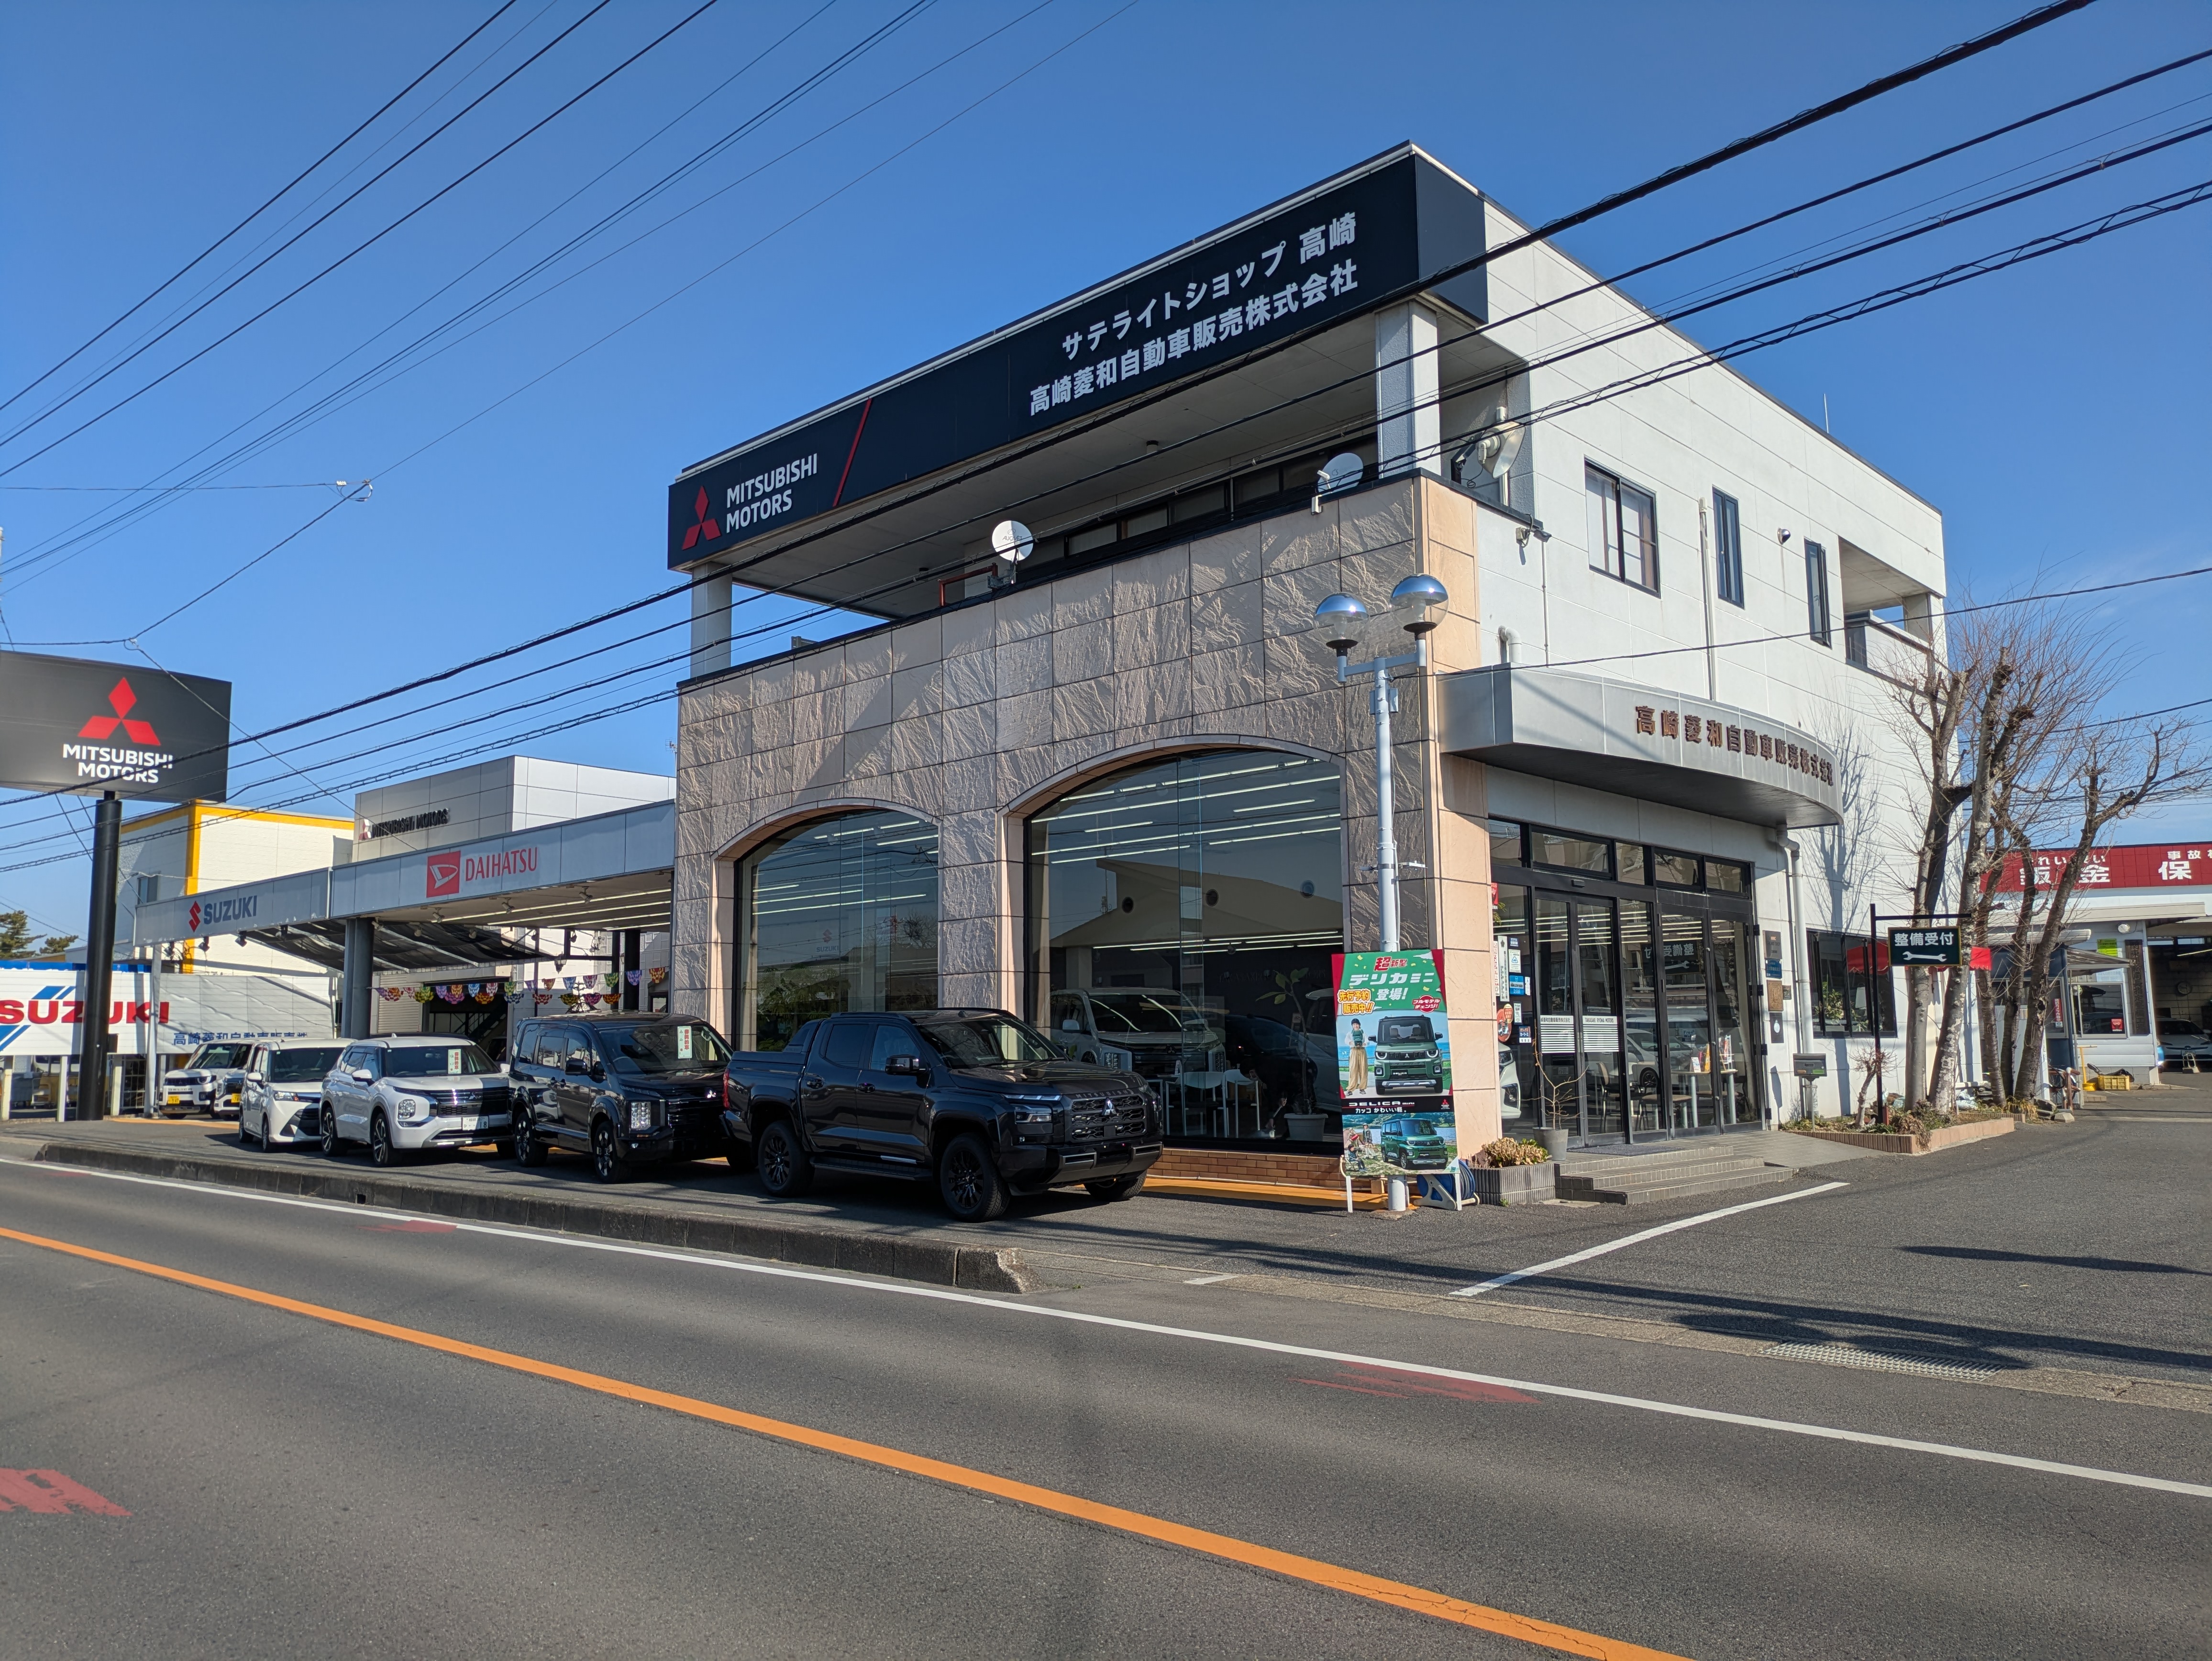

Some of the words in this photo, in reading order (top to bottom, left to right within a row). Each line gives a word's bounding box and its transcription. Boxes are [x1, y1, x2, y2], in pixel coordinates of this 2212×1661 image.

[1062, 241, 1287, 360] サテライトショップ
[1299, 212, 1356, 265] 高崎
[1030, 258, 1359, 416] 高崎菱和自動車販売株式会社
[727, 453, 818, 509] MITSUBISHI
[726, 488, 792, 533] MOTORS
[62, 743, 173, 769] MITSUBISHI
[1635, 705, 1834, 786] 高崎菱和自動車販売株式会社
[77, 762, 159, 784] MOTORS
[372, 815, 416, 839] MITSUBISHI
[416, 808, 450, 830] MOTORS
[465, 847, 537, 882] DAIHATSU
[2031, 856, 2067, 865] れい
[204, 895, 258, 925] SUZUKI
[1894, 931, 1954, 946] 整備受付
[1373, 956, 1408, 972] 超新型
[1349, 972, 1435, 986] デリカミニ
[1338, 989, 1371, 1002] 先行予約
[1375, 987, 1408, 1001] 登場!
[0, 999, 170, 1025] SUZUKI
